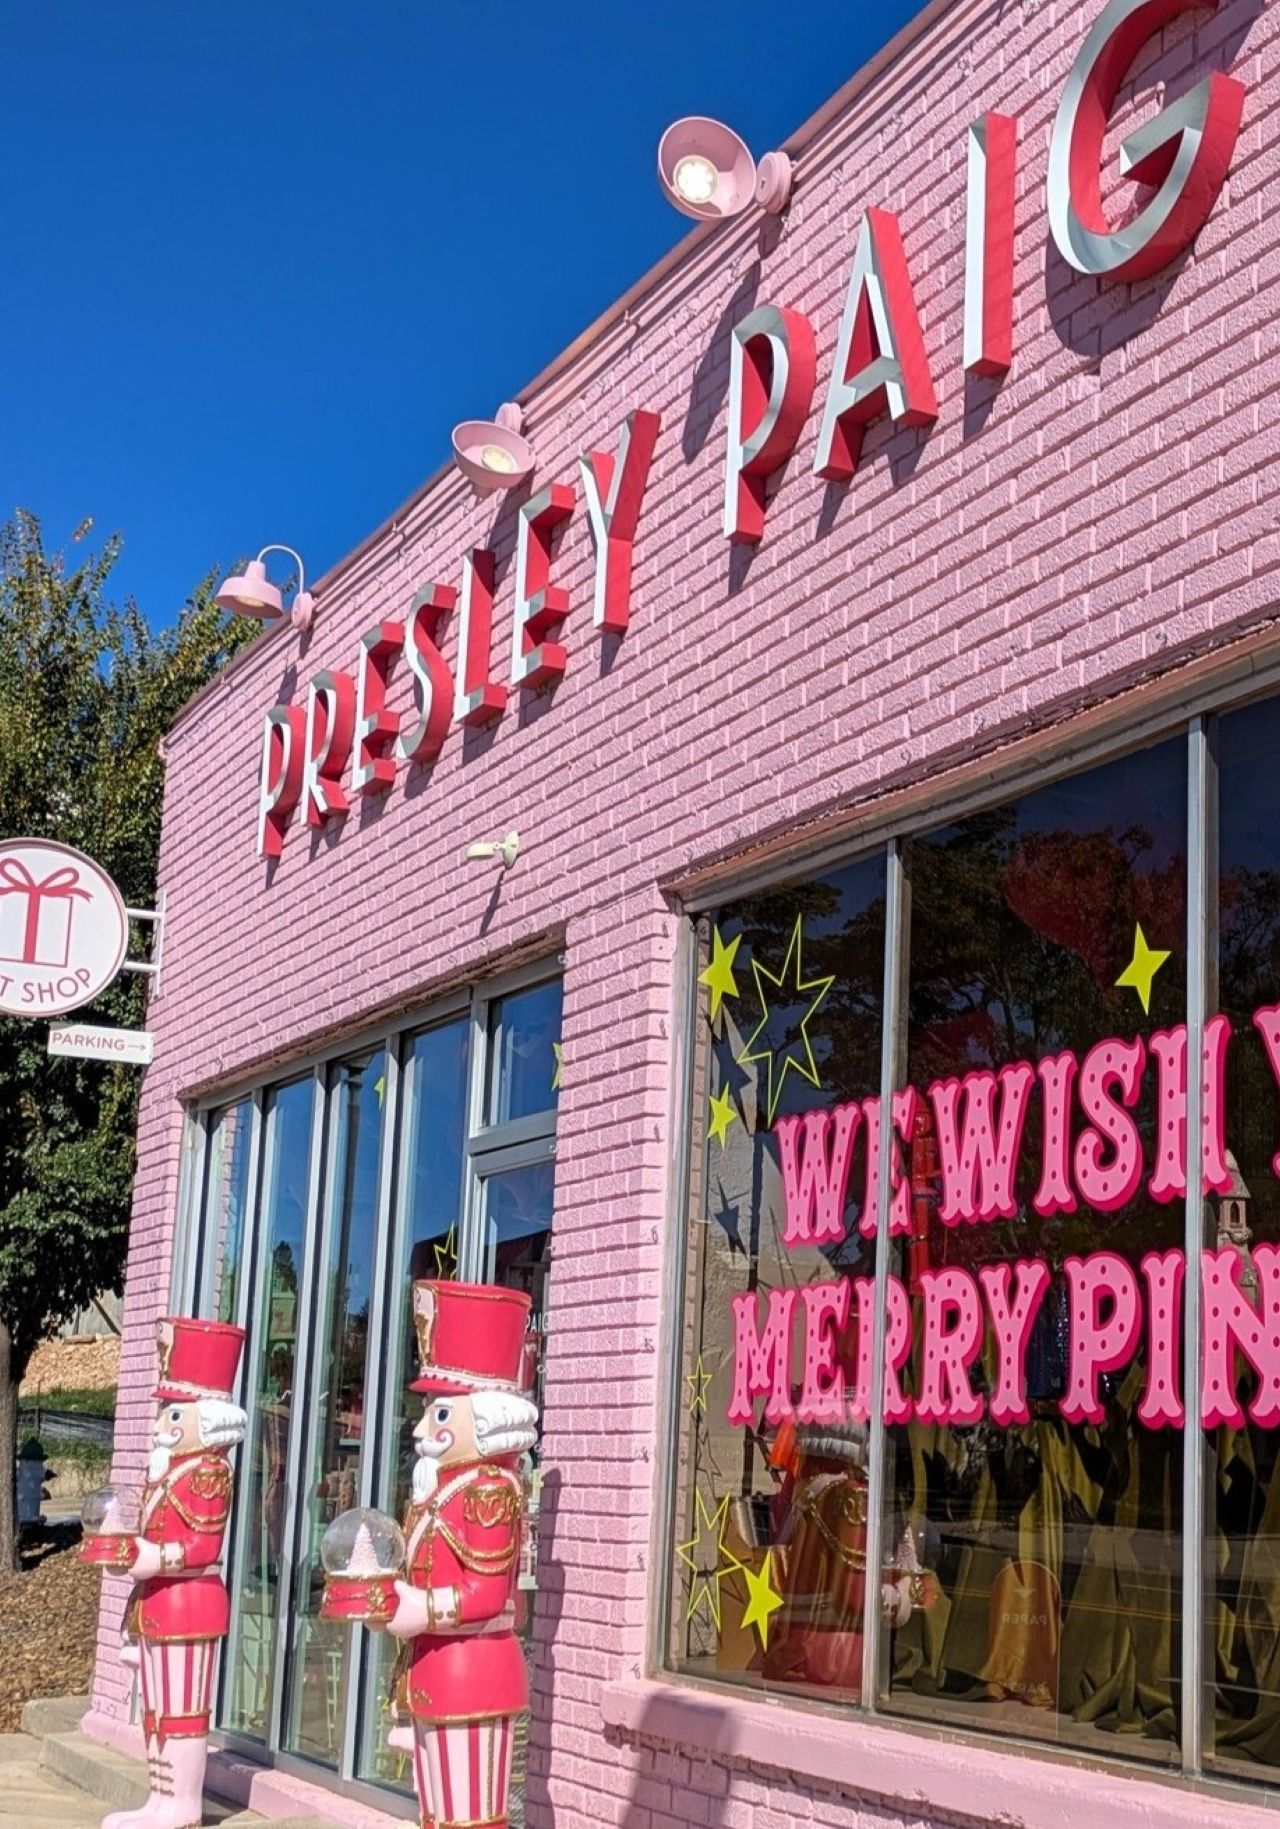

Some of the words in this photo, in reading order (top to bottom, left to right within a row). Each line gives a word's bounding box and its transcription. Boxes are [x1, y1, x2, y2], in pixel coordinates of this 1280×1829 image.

[257, 409, 661, 858] PRESLEY
[21, 968, 91, 1003] SHOP
[53, 1032, 125, 1050] PARKING
[774, 1084, 916, 1248] WE
[928, 1012, 1233, 1228] WISH
[726, 1256, 1051, 1428] MERRY
